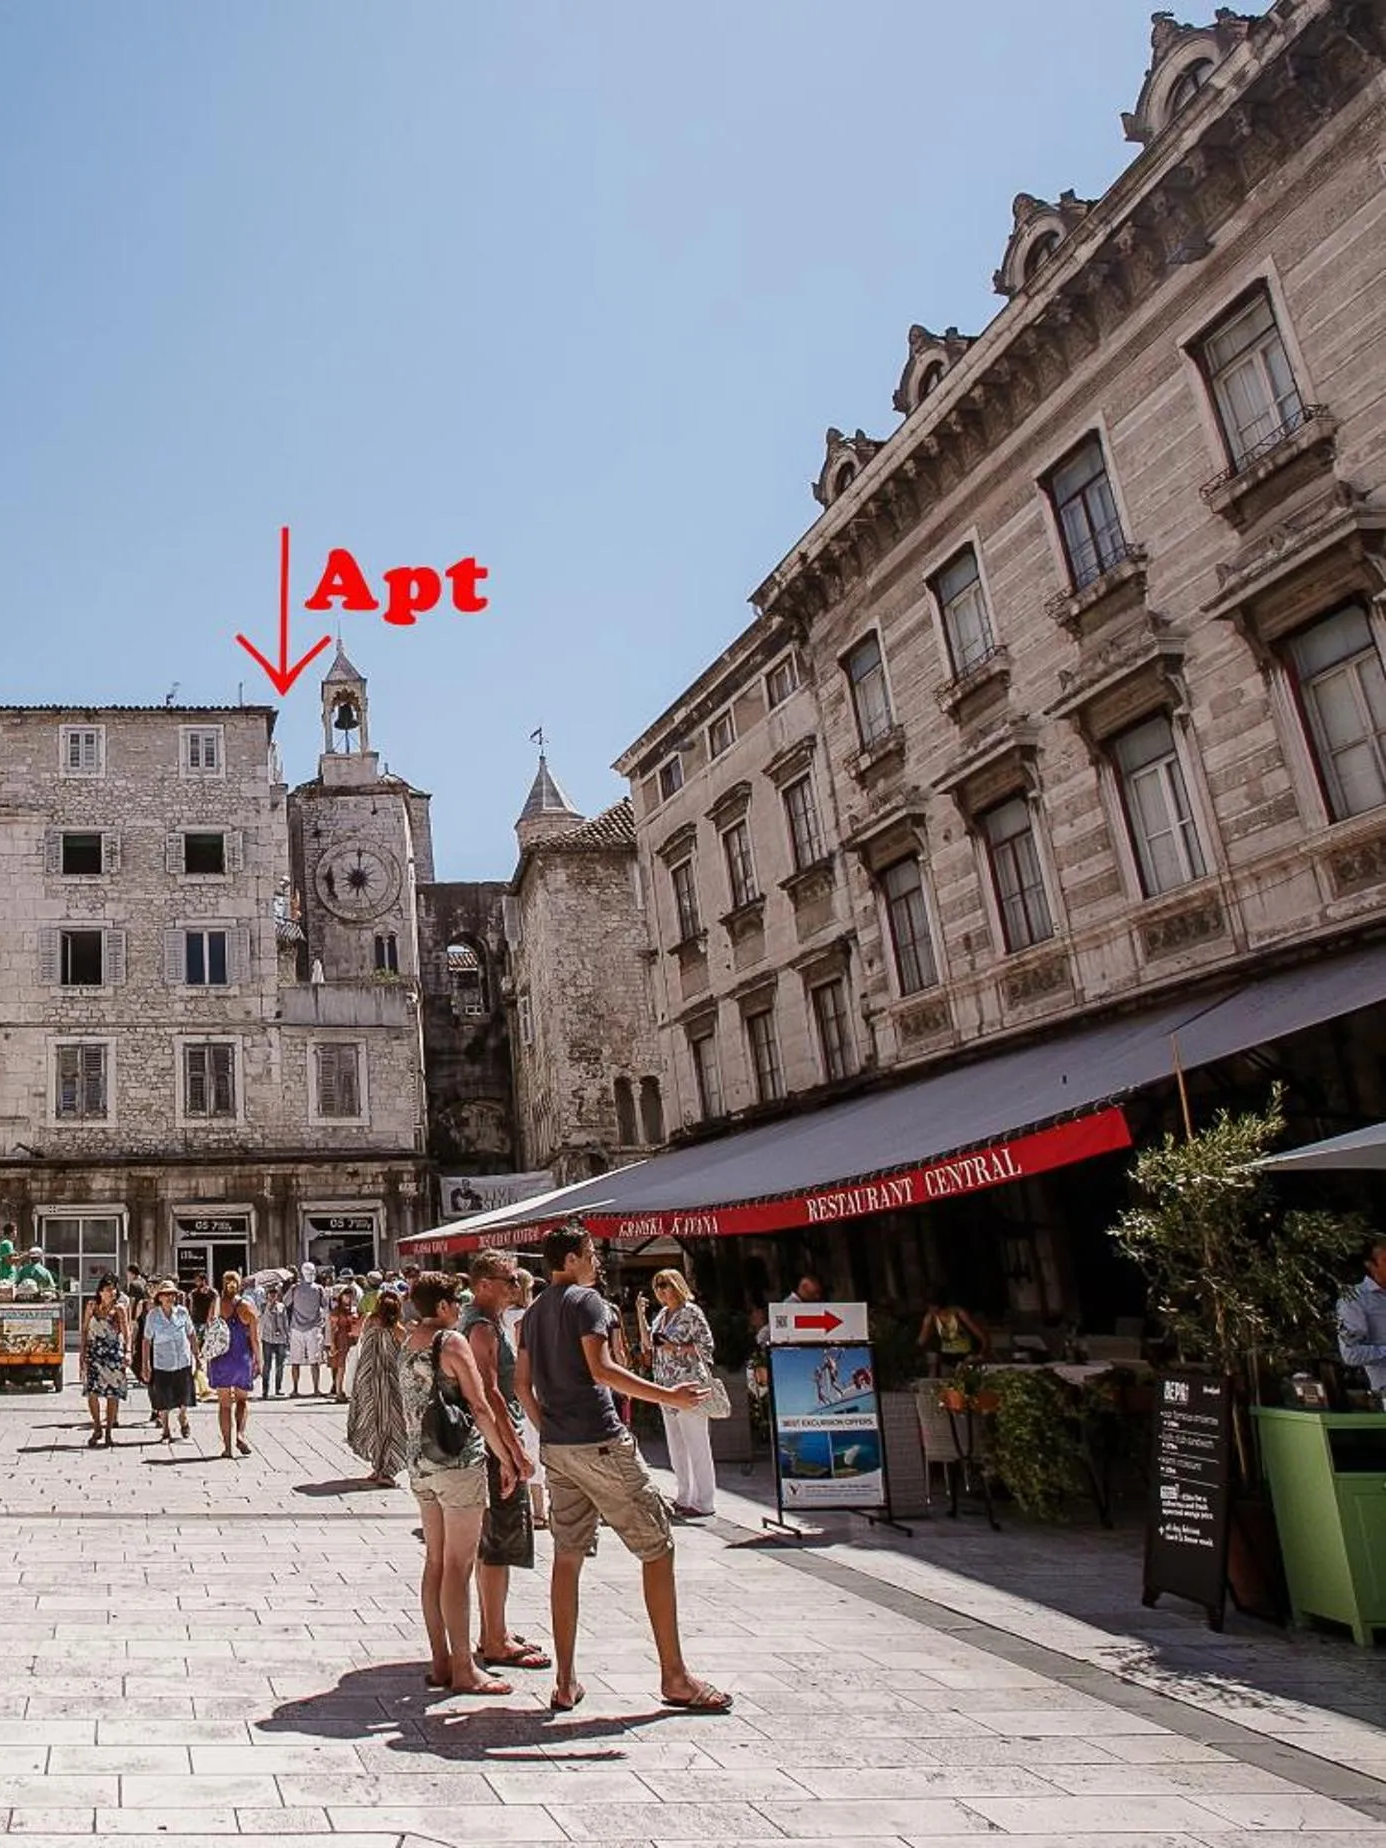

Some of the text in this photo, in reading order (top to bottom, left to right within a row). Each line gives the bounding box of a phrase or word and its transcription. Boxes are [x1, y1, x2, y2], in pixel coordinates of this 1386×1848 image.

[806, 1147, 1023, 1223] RESTAURANT CENTRAL
[801, 1418, 843, 1427] EXCURSION
[845, 1417, 874, 1426] OFFERS
